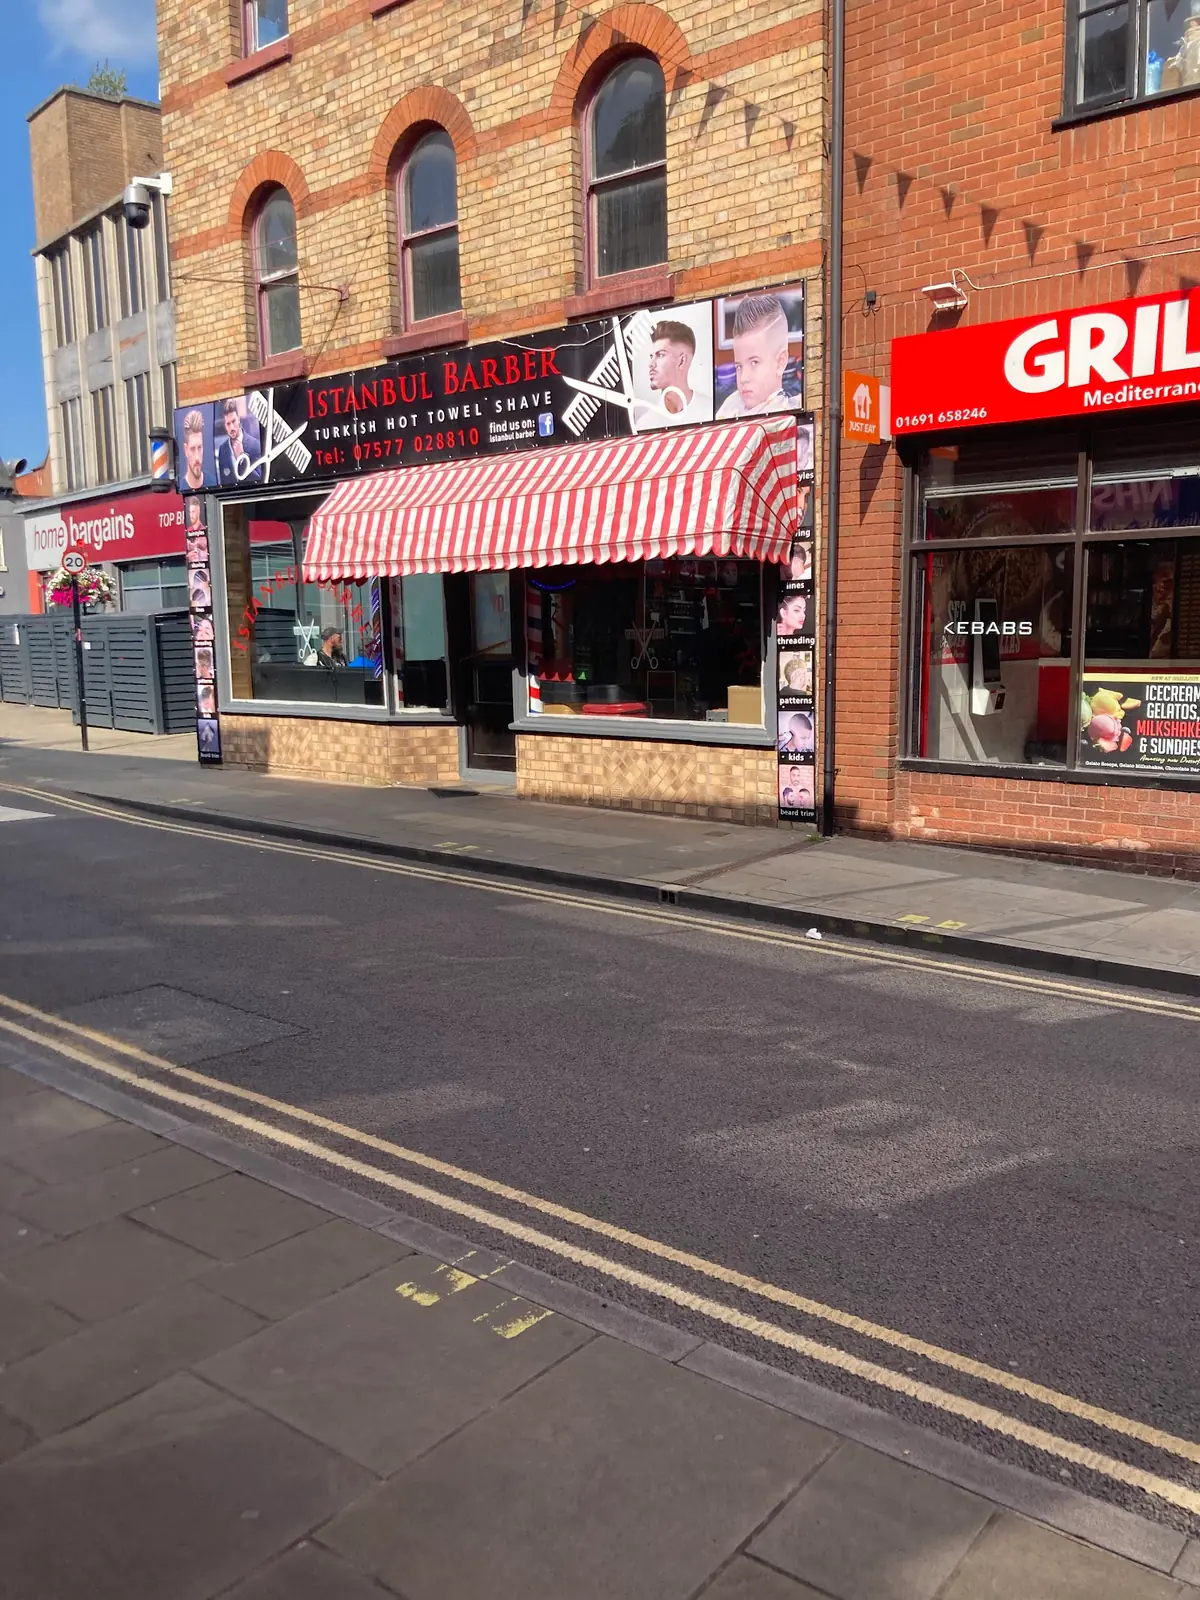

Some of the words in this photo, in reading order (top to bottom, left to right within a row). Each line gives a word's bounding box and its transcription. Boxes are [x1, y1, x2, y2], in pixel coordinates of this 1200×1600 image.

[1003, 299, 1200, 394] GRIL
[307, 371, 433, 419] ISTANBUL
[443, 346, 561, 396] BARBER
[314, 420, 377, 441] TURKISH
[387, 414, 418, 430] HOT
[427, 403, 482, 424] TOWEL
[495, 391, 552, 414] SHAVE
[895, 412, 934, 428] 01691
[937, 407, 987, 424] 658246
[489, 420, 508, 434] find
[509, 421, 520, 431] us
[521, 419, 536, 429] on:
[849, 421, 864, 433] JUST
[864, 423, 876, 434] EAT
[515, 430, 536, 440] barber
[315, 448, 345, 467] Tel:
[353, 438, 404, 460] 07577
[414, 427, 480, 453] 028810
[33, 524, 65, 551] home
[69, 509, 135, 551] bargains
[158, 512, 175, 528] TOP
[65, 557, 83, 568] 20
[777, 636, 815, 646] threading
[779, 697, 813, 706] patterns
[1140, 738, 1148, 753] &
[788, 753, 805, 761] kids
[780, 808, 799, 817] beard
